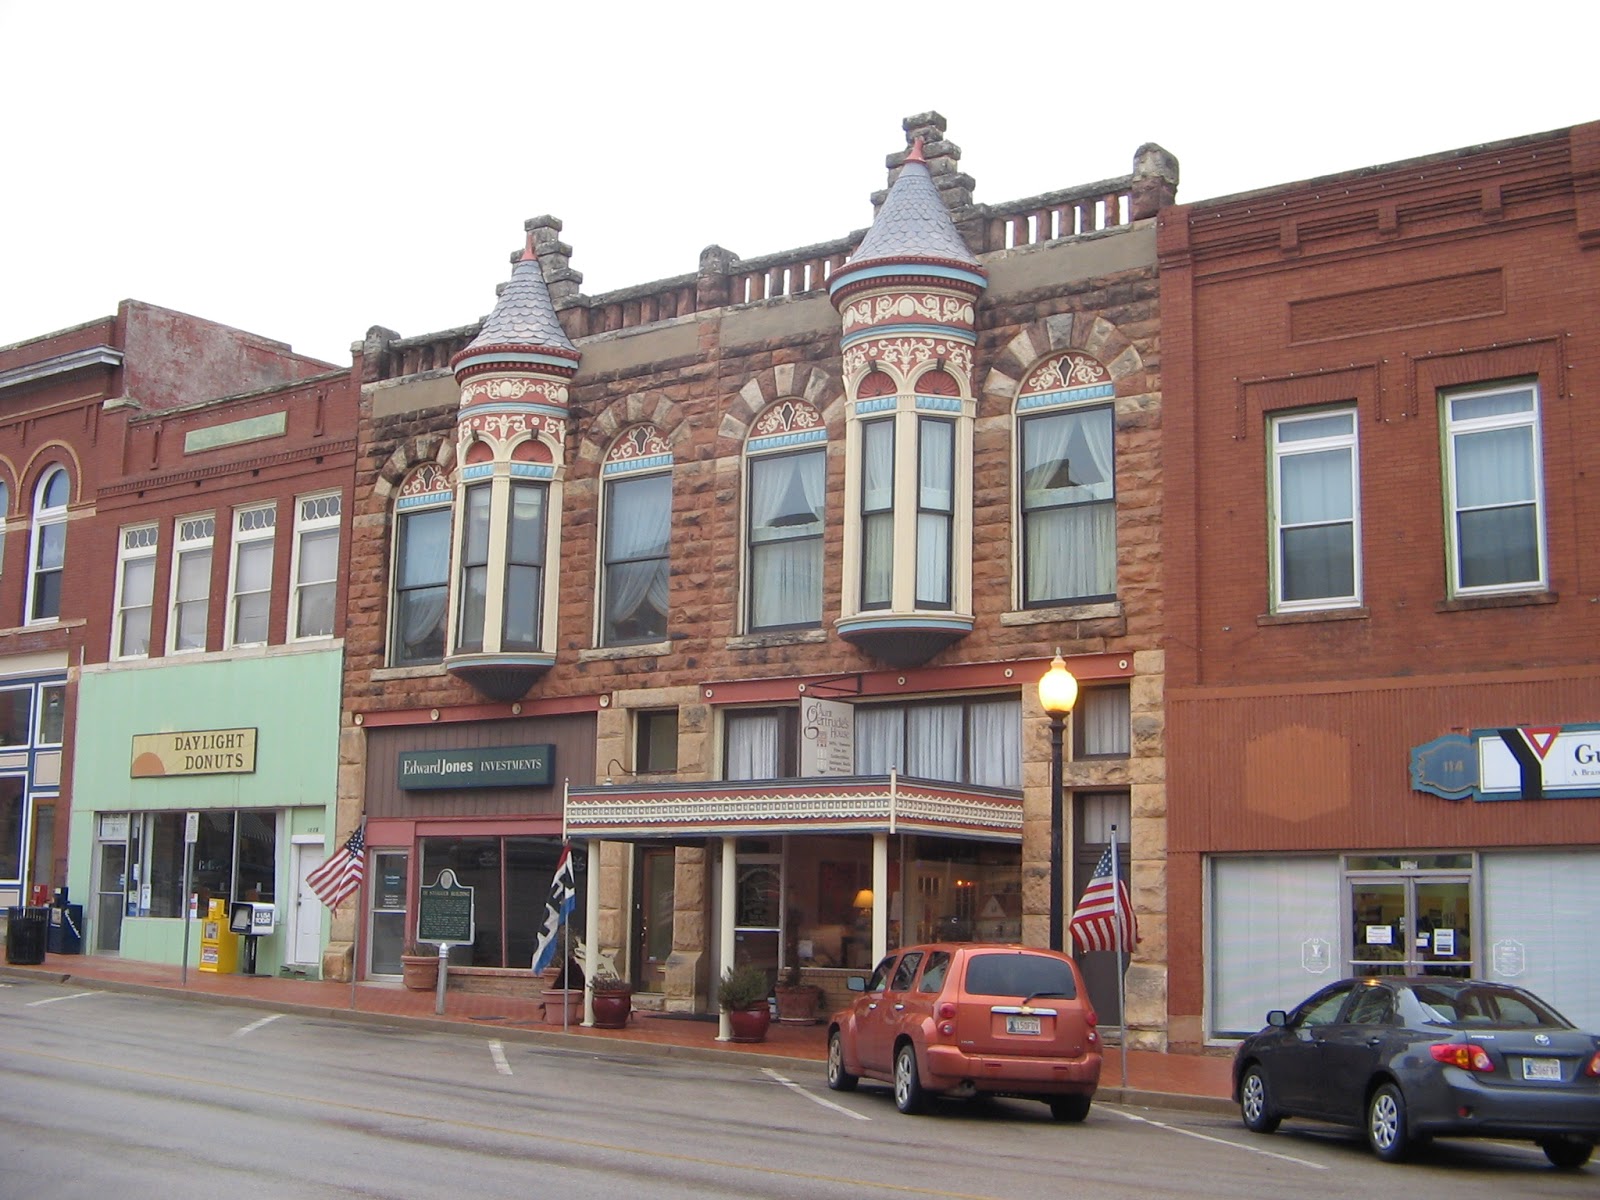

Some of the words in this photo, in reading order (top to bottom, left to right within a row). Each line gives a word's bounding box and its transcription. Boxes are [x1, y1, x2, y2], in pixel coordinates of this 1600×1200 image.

[174, 733, 245, 751] DAYLIGHT
[185, 753, 243, 770] DONUTS
[480, 758, 542, 772] INVESTMENTS
